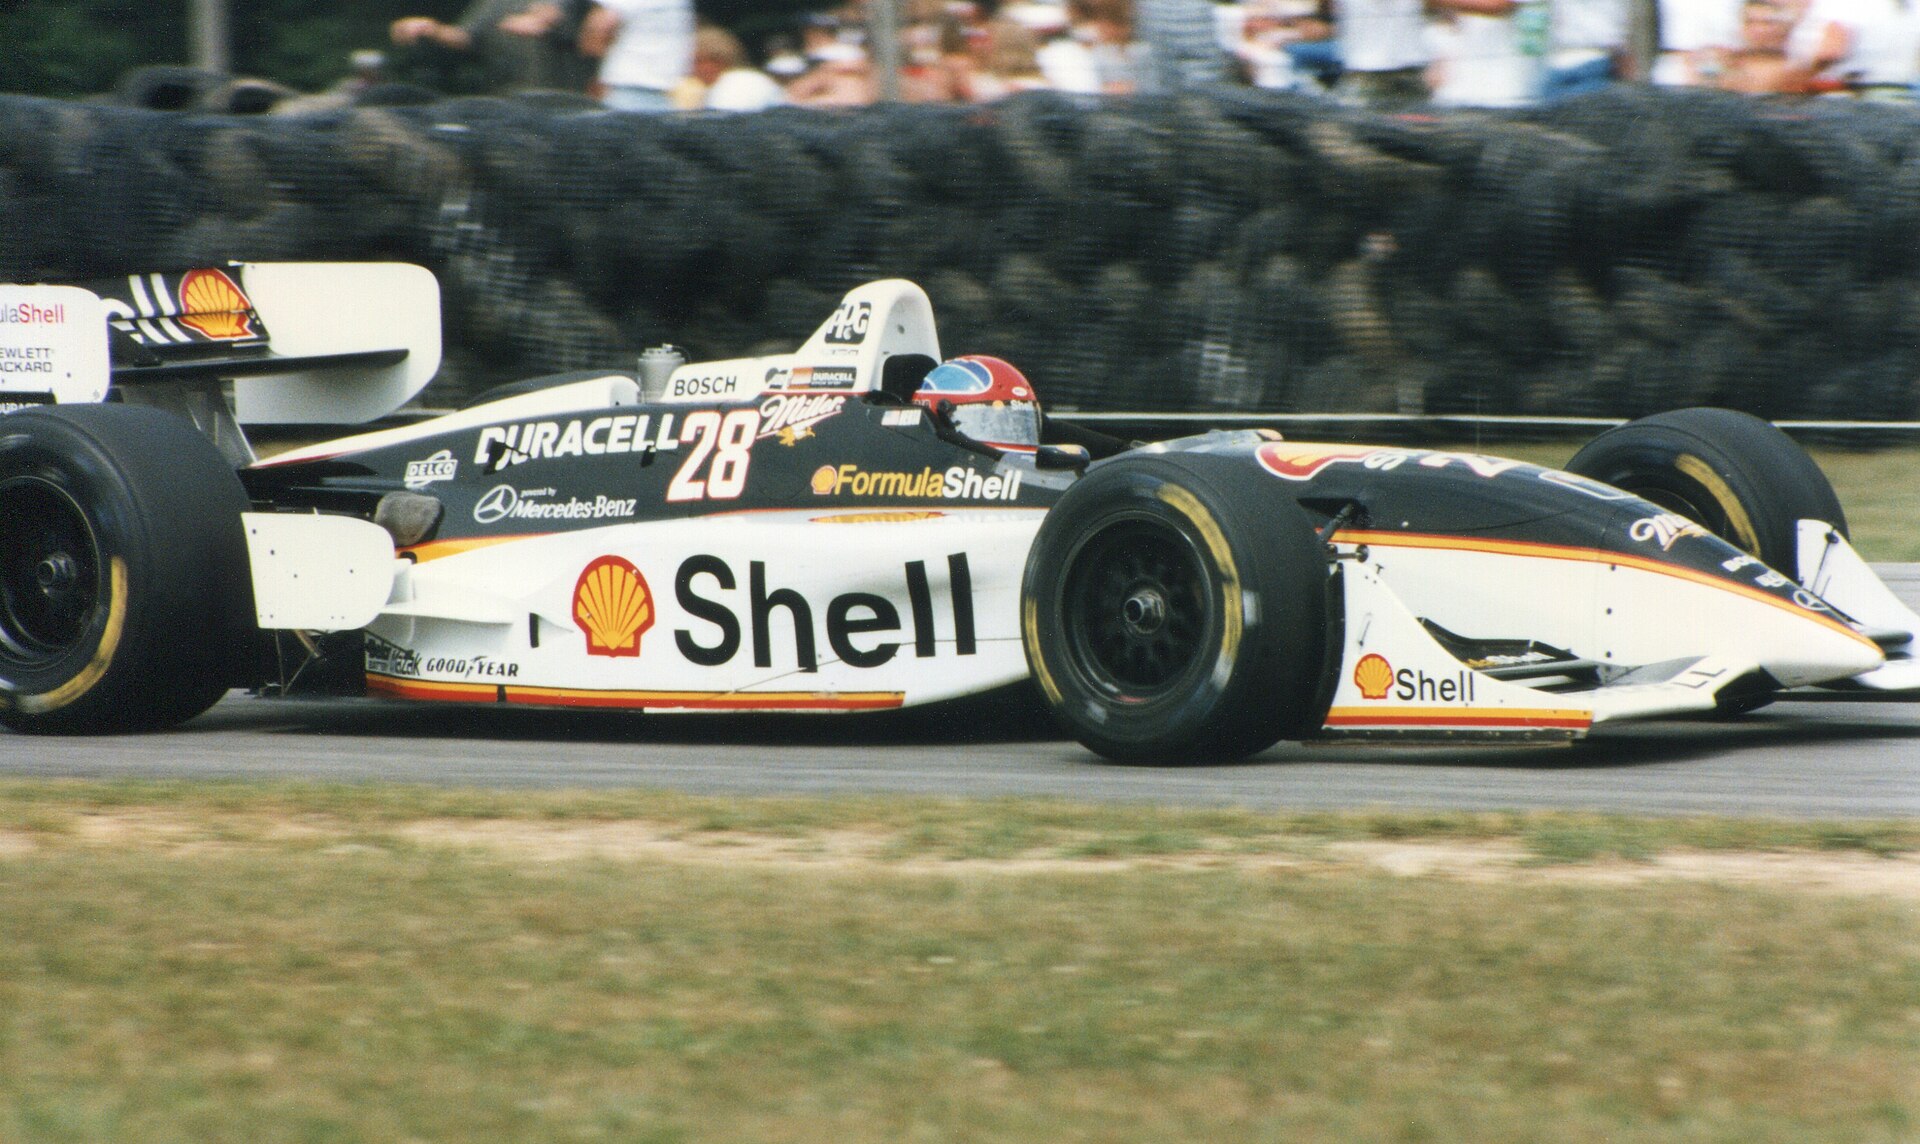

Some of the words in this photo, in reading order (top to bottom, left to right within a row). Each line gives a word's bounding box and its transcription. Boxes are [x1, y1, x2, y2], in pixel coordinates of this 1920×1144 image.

[674, 376, 737, 396] BOSCH
[813, 372, 854, 382] DURACELL
[759, 394, 846, 434] Miller
[474, 413, 680, 471] DURACELL
[664, 407, 761, 503] 28
[408, 461, 454, 477] DELCO
[834, 464, 1022, 501] FormulaShell
[509, 495, 637, 519] Mercedes-Benz
[673, 551, 977, 673] Shell
[1396, 668, 1475, 702] Shell
